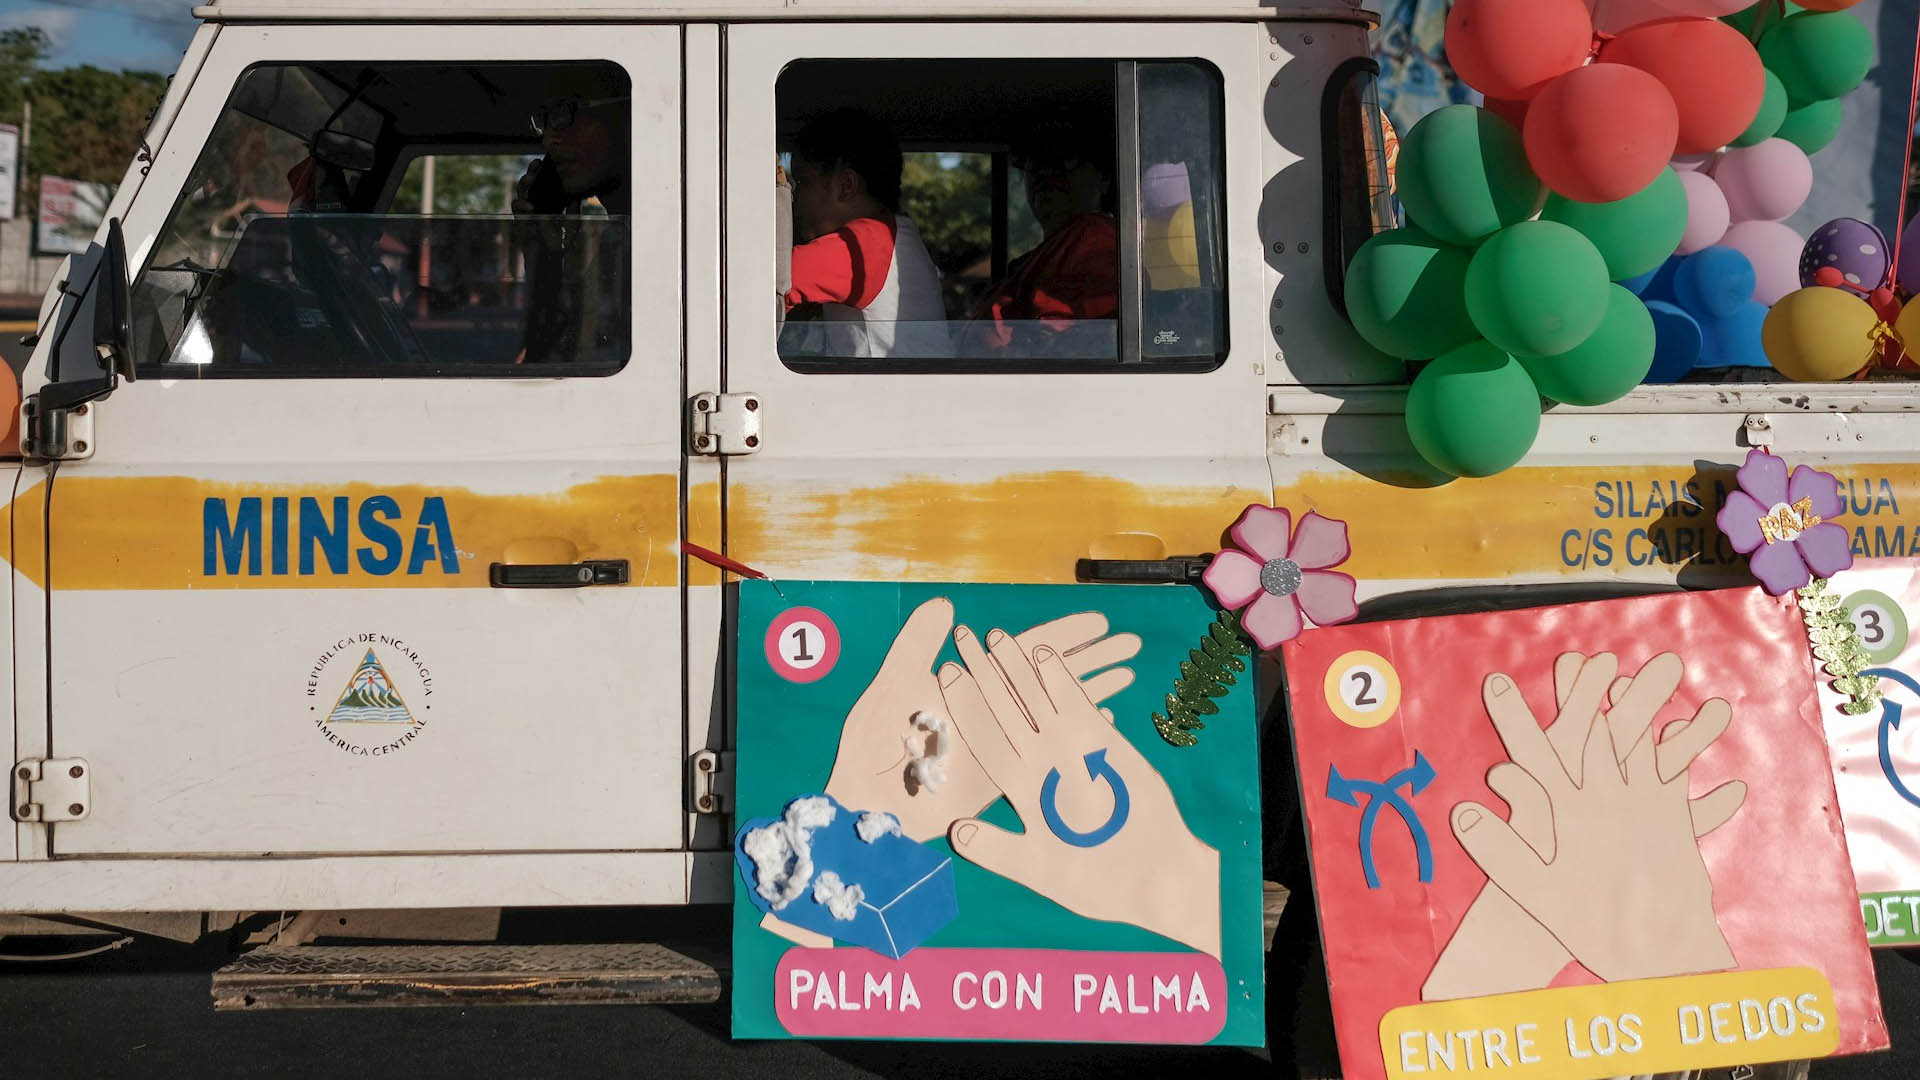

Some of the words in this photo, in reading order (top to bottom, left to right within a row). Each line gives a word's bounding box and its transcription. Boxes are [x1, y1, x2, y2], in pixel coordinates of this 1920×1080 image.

[1594, 480, 1702, 519] SILAIS
[1757, 496, 1822, 545] PAZ
[203, 495, 461, 576] MINSA
[1561, 528, 1613, 571] C/S
[1626, 526, 1748, 567] CARLO
[792, 627, 814, 661] 1
[1860, 609, 1885, 643] 3
[307, 637, 356, 696] REPUBLICA
[359, 633, 377, 642] DE
[380, 634, 433, 697] NICARAGUA
[1351, 671, 1377, 706] 2
[315, 718, 369, 756] AMERICA
[372, 719, 427, 757] CENTRAL
[789, 969, 921, 1011] PALMA
[952, 970, 1042, 1011] CON
[1074, 970, 1210, 1013] PALMA
[1399, 1023, 1540, 1073] ENTRE
[1565, 1013, 1643, 1058] LOS
[1678, 993, 1826, 1045] DEDOS
